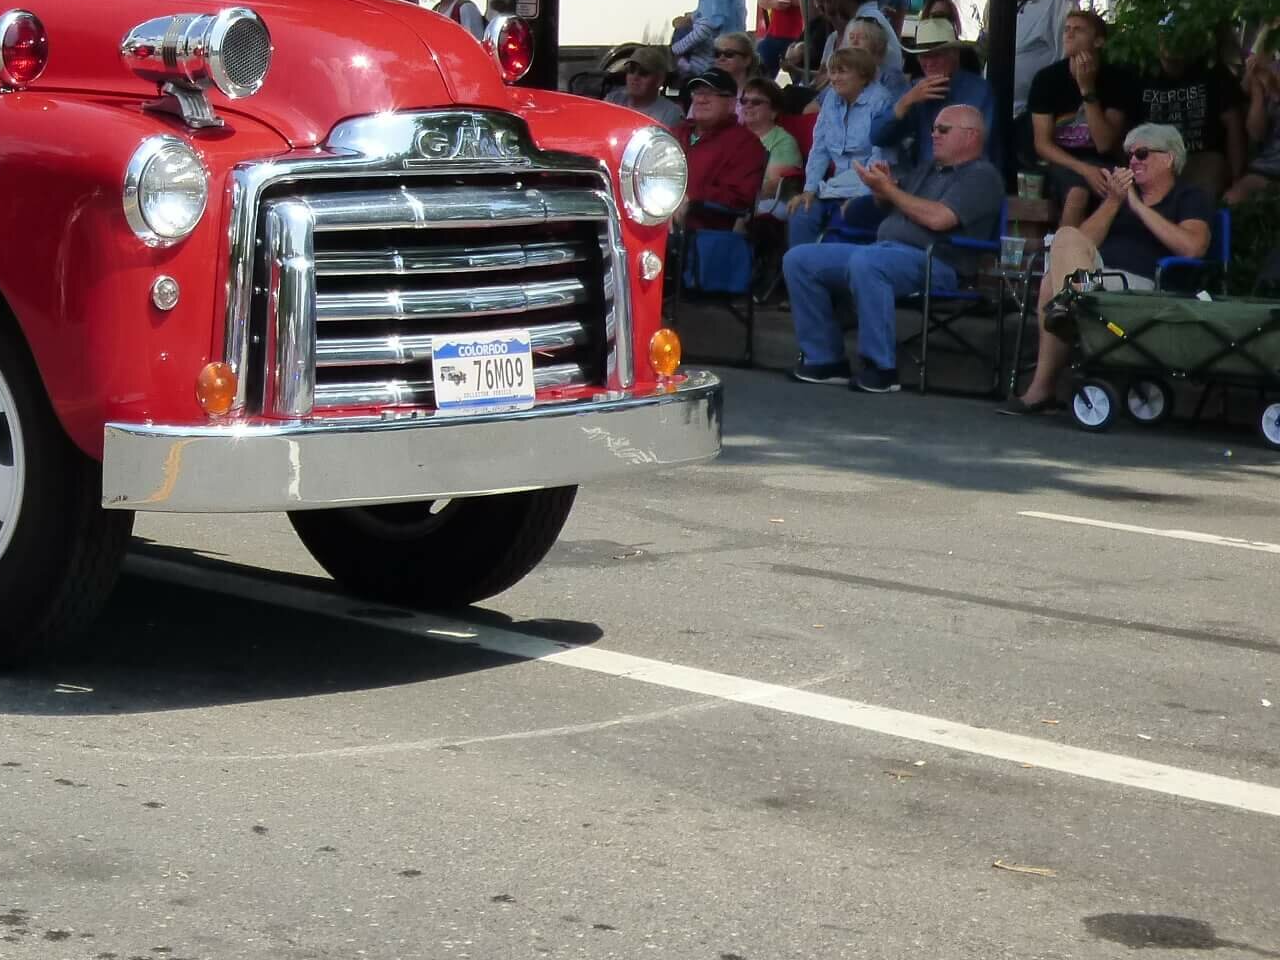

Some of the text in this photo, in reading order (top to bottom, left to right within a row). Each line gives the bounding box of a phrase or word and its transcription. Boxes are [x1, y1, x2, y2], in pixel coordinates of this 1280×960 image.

[1142, 84, 1206, 104] EXERCISE
[414, 125, 522, 160] GMC
[458, 343, 508, 357] COLORADO
[473, 357, 524, 391] 76M09
